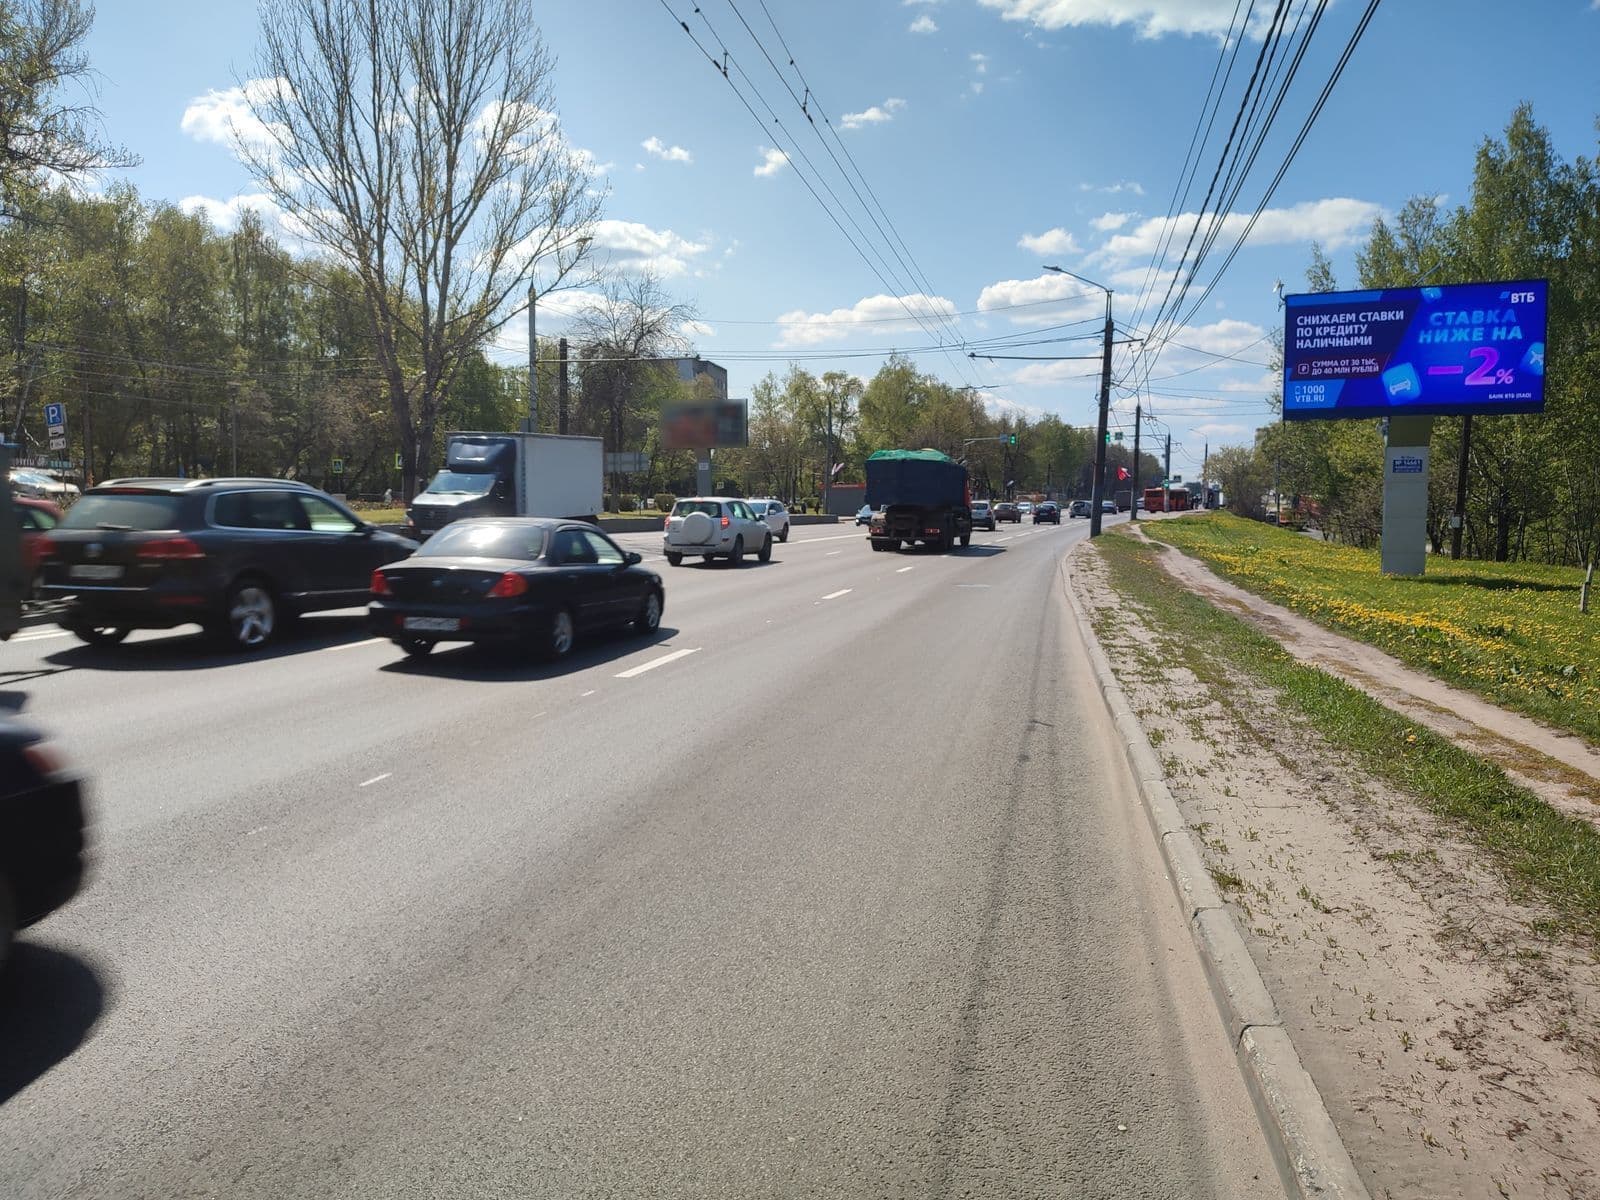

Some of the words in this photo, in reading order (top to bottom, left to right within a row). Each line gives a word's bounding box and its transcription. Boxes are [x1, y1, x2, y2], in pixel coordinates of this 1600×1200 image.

[1511, 292, 1535, 304] ВТБ
[1296, 313, 1356, 325] СНИЖАЕМ
[1358, 310, 1404, 322] СТАВКИ
[1430, 309, 1517, 325] СТАВКА
[1296, 327, 1313, 337] ПО
[1315, 324, 1368, 336] КРЕДИТУ
[1418, 327, 1485, 343] НИЖЕ
[1491, 326, 1523, 340] НА
[1296, 336, 1373, 349] НАЛИЧНЫМИ
[1311, 367, 1323, 375] ДО
[1351, 365, 1379, 373] РУБЛЕЙ
[1303, 385, 1325, 394] 1000
[1295, 394, 1325, 403] VTB.RU
